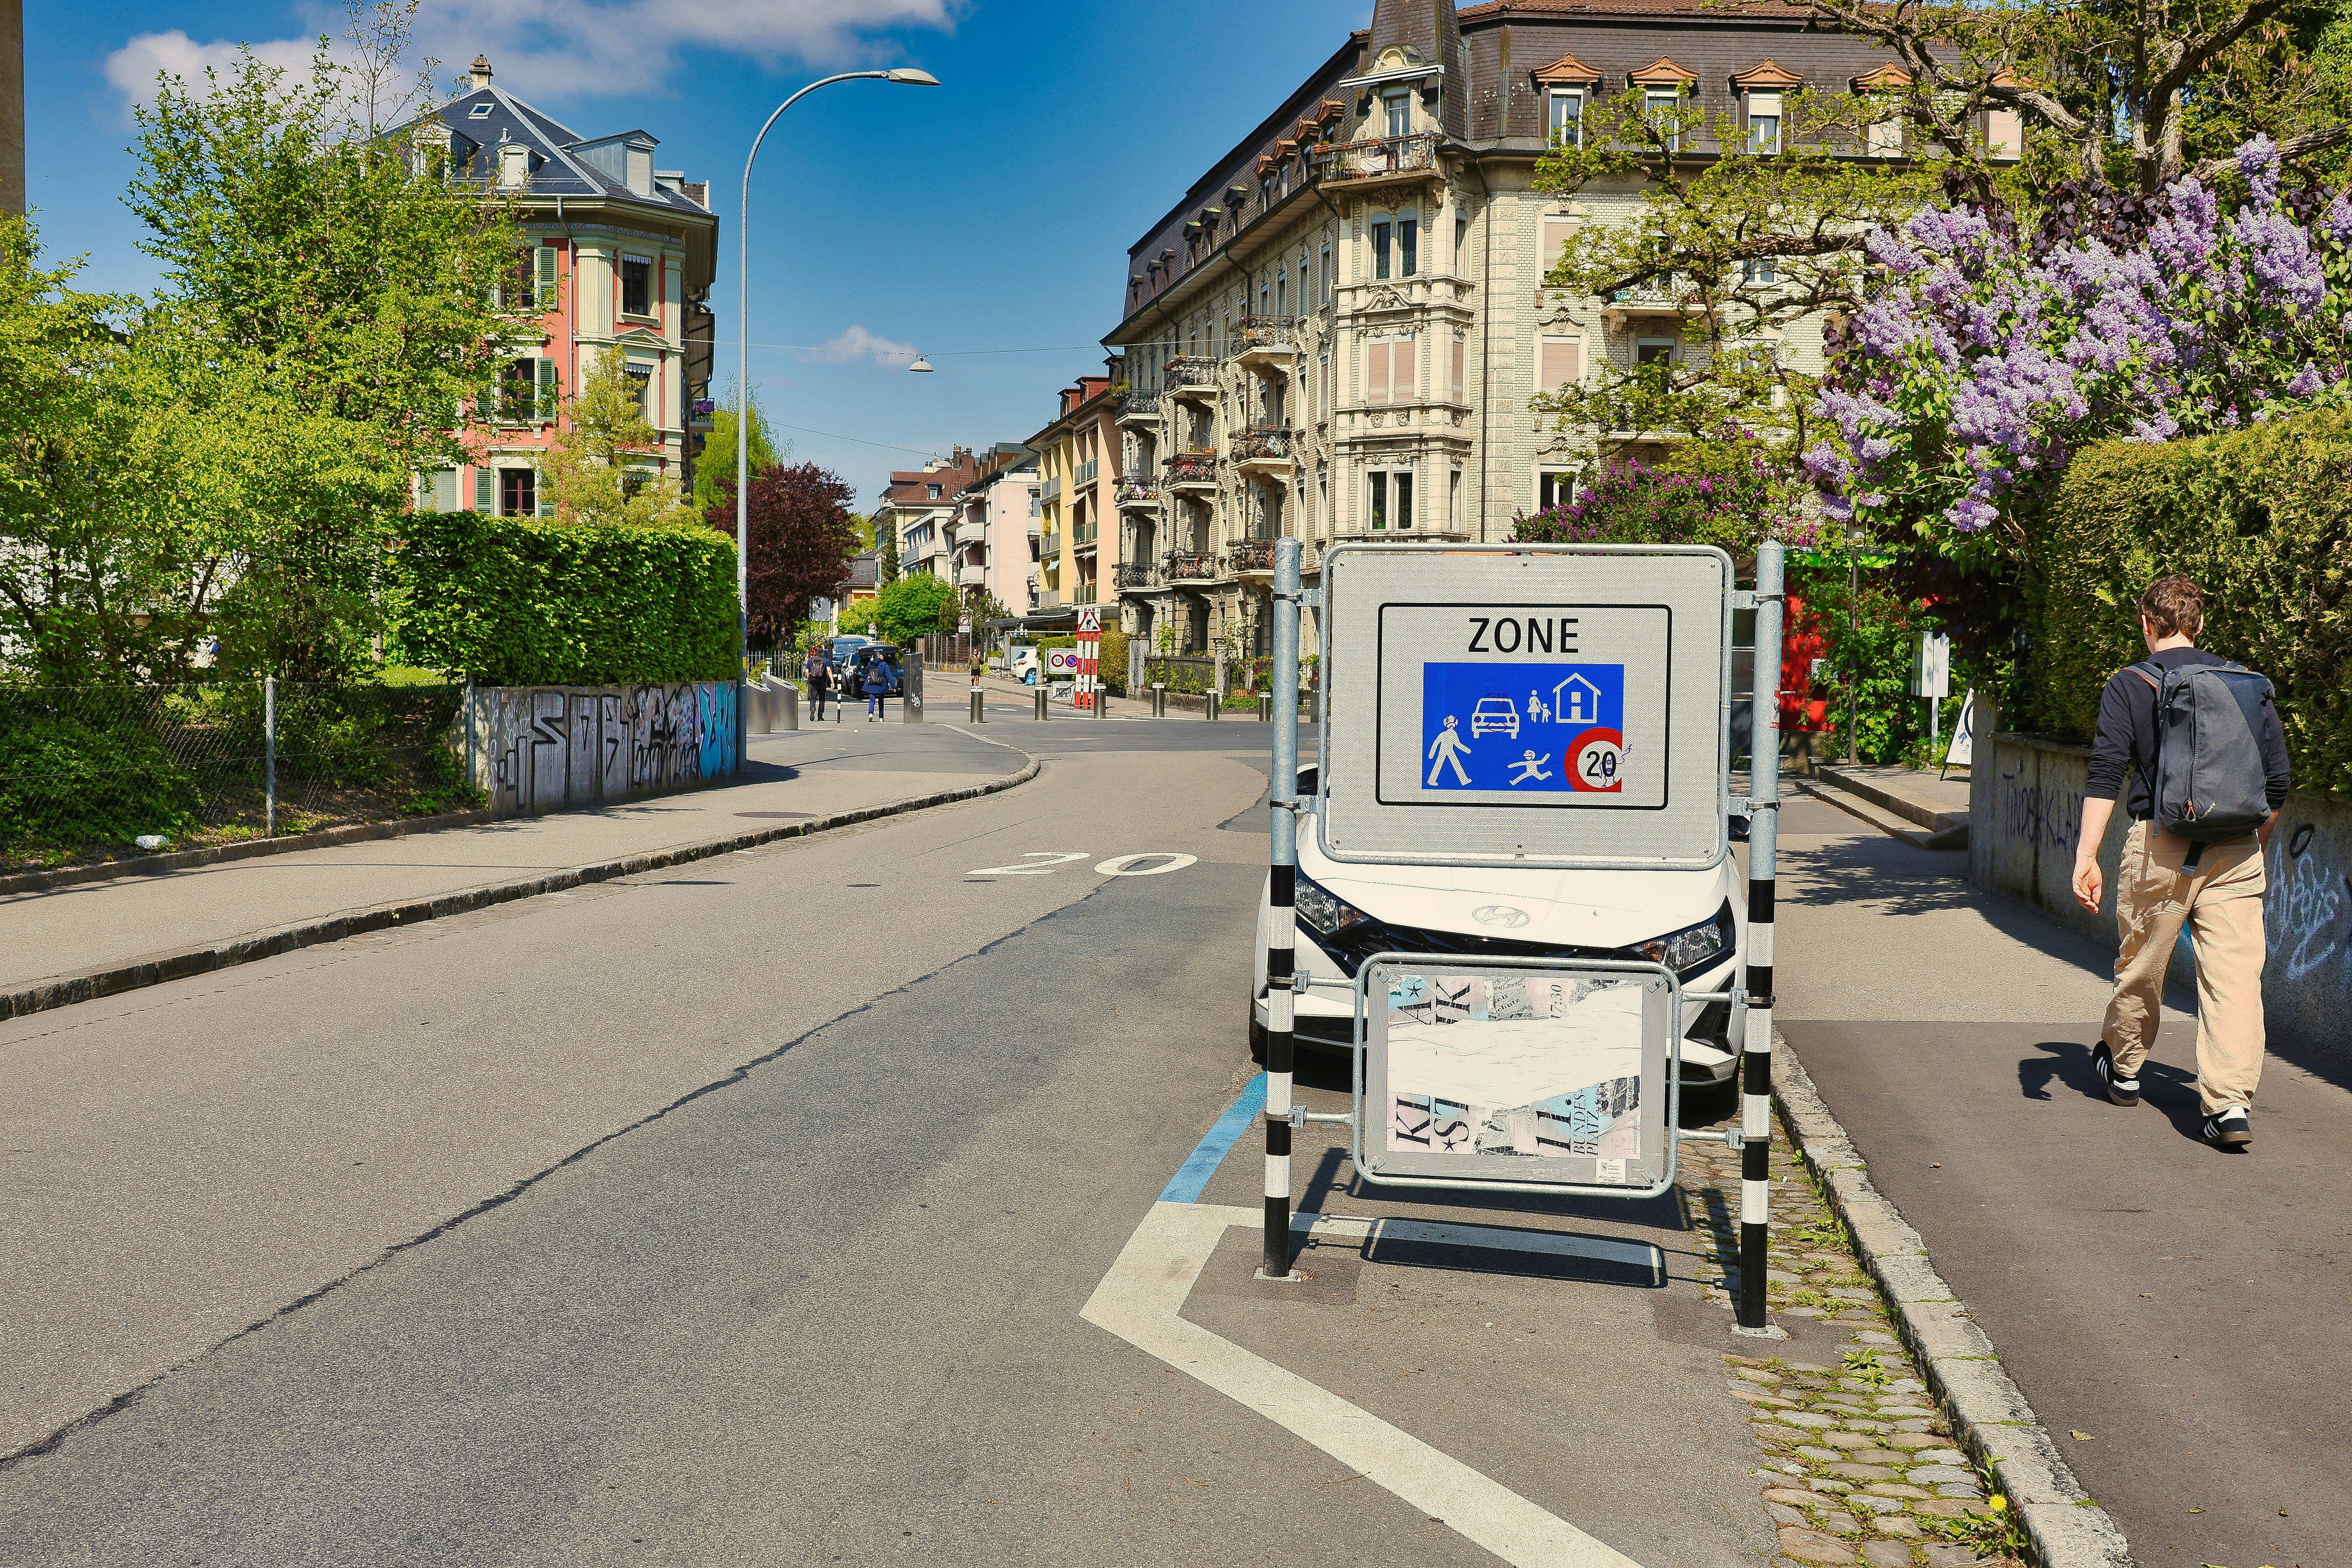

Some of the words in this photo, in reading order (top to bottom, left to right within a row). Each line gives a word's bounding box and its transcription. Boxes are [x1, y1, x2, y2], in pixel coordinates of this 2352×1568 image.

[1468, 617, 1580, 654] ZONE
[1586, 751, 1616, 777] 20
[964, 852, 1198, 876] 20
[1550, 984, 1563, 1018] 17:30
[1535, 1099, 1572, 1155] 11.
[1586, 1110, 1599, 1157] PLATZ
